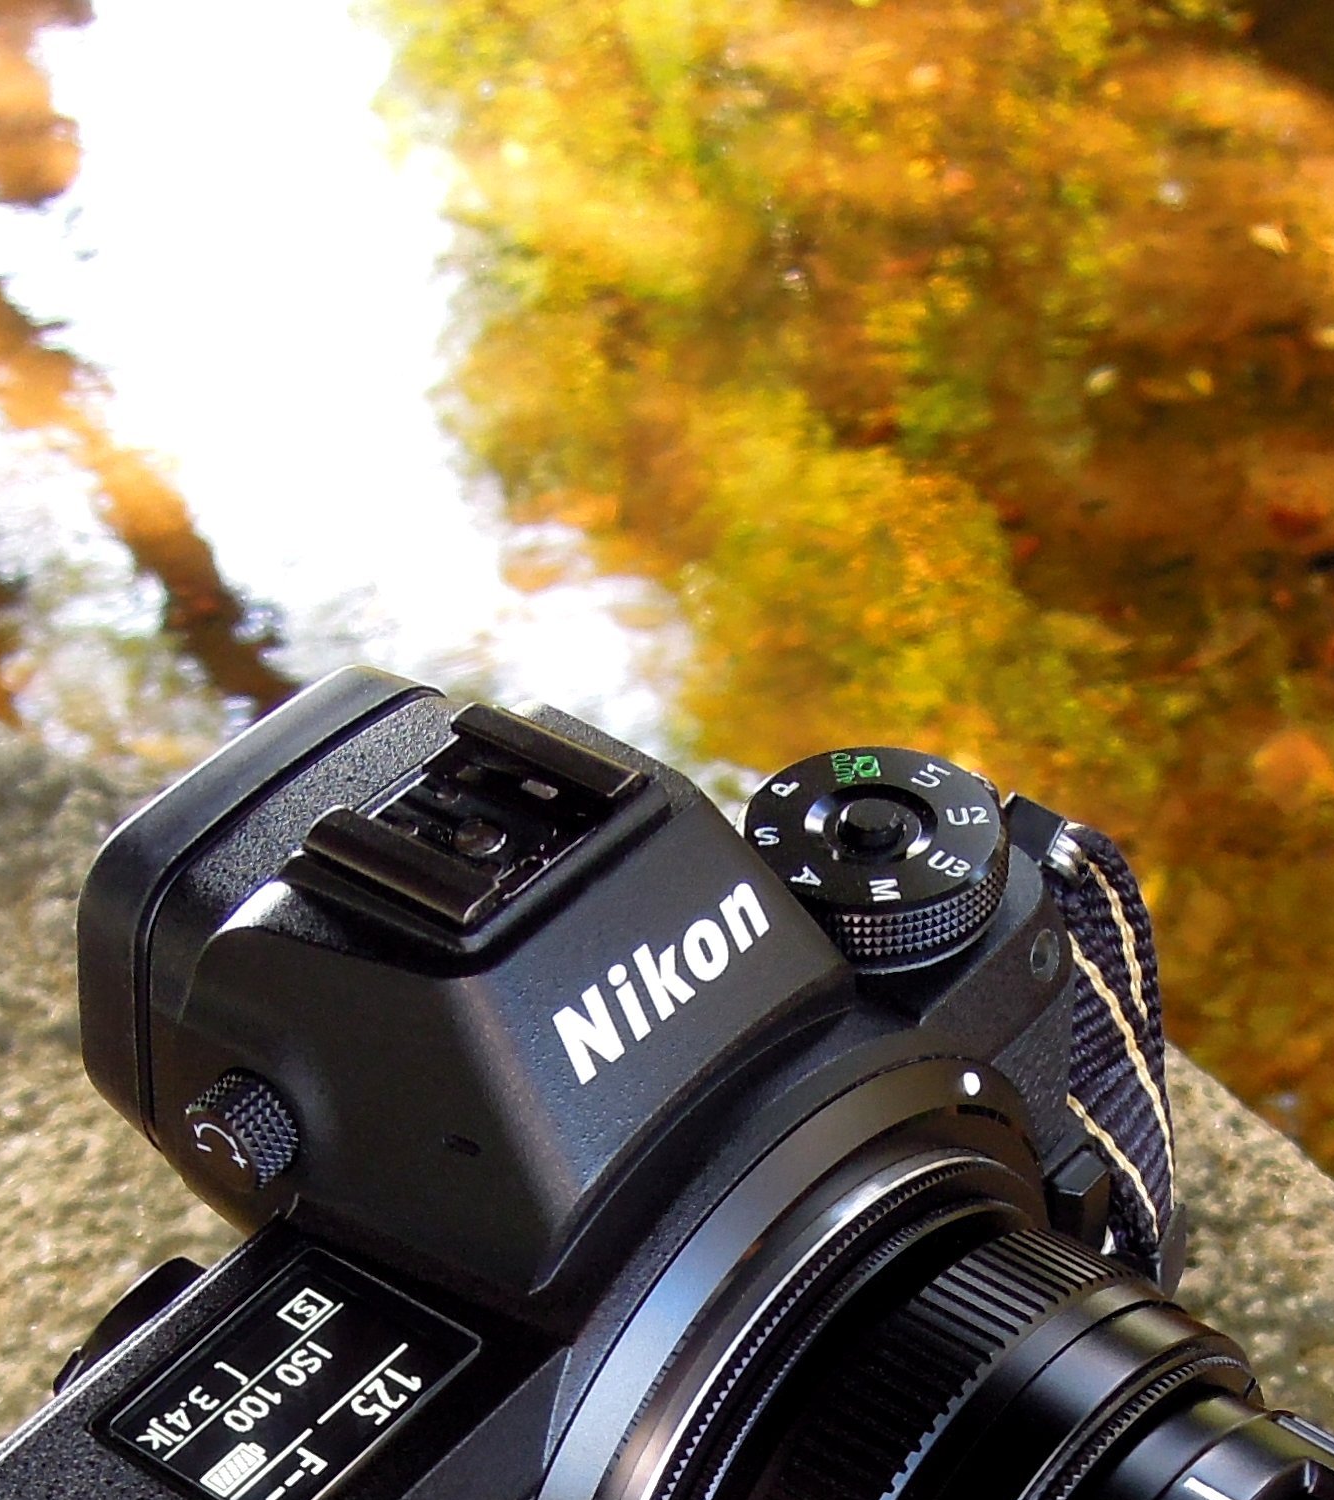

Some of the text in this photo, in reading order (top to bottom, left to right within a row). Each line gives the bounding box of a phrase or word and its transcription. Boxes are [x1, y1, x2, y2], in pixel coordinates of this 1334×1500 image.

[770, 780, 801, 798] P
[910, 762, 952, 791] U1
[946, 805, 992, 827] U2
[753, 825, 781, 847] S
[789, 864, 823, 887] A
[926, 849, 972, 879] U3
[868, 877, 903, 903] M
[552, 880, 770, 1086] Nikon
[293, 1297, 319, 1319] S
[223, 1340, 334, 1434] ISO 100
[350, 1367, 423, 1426] 125
